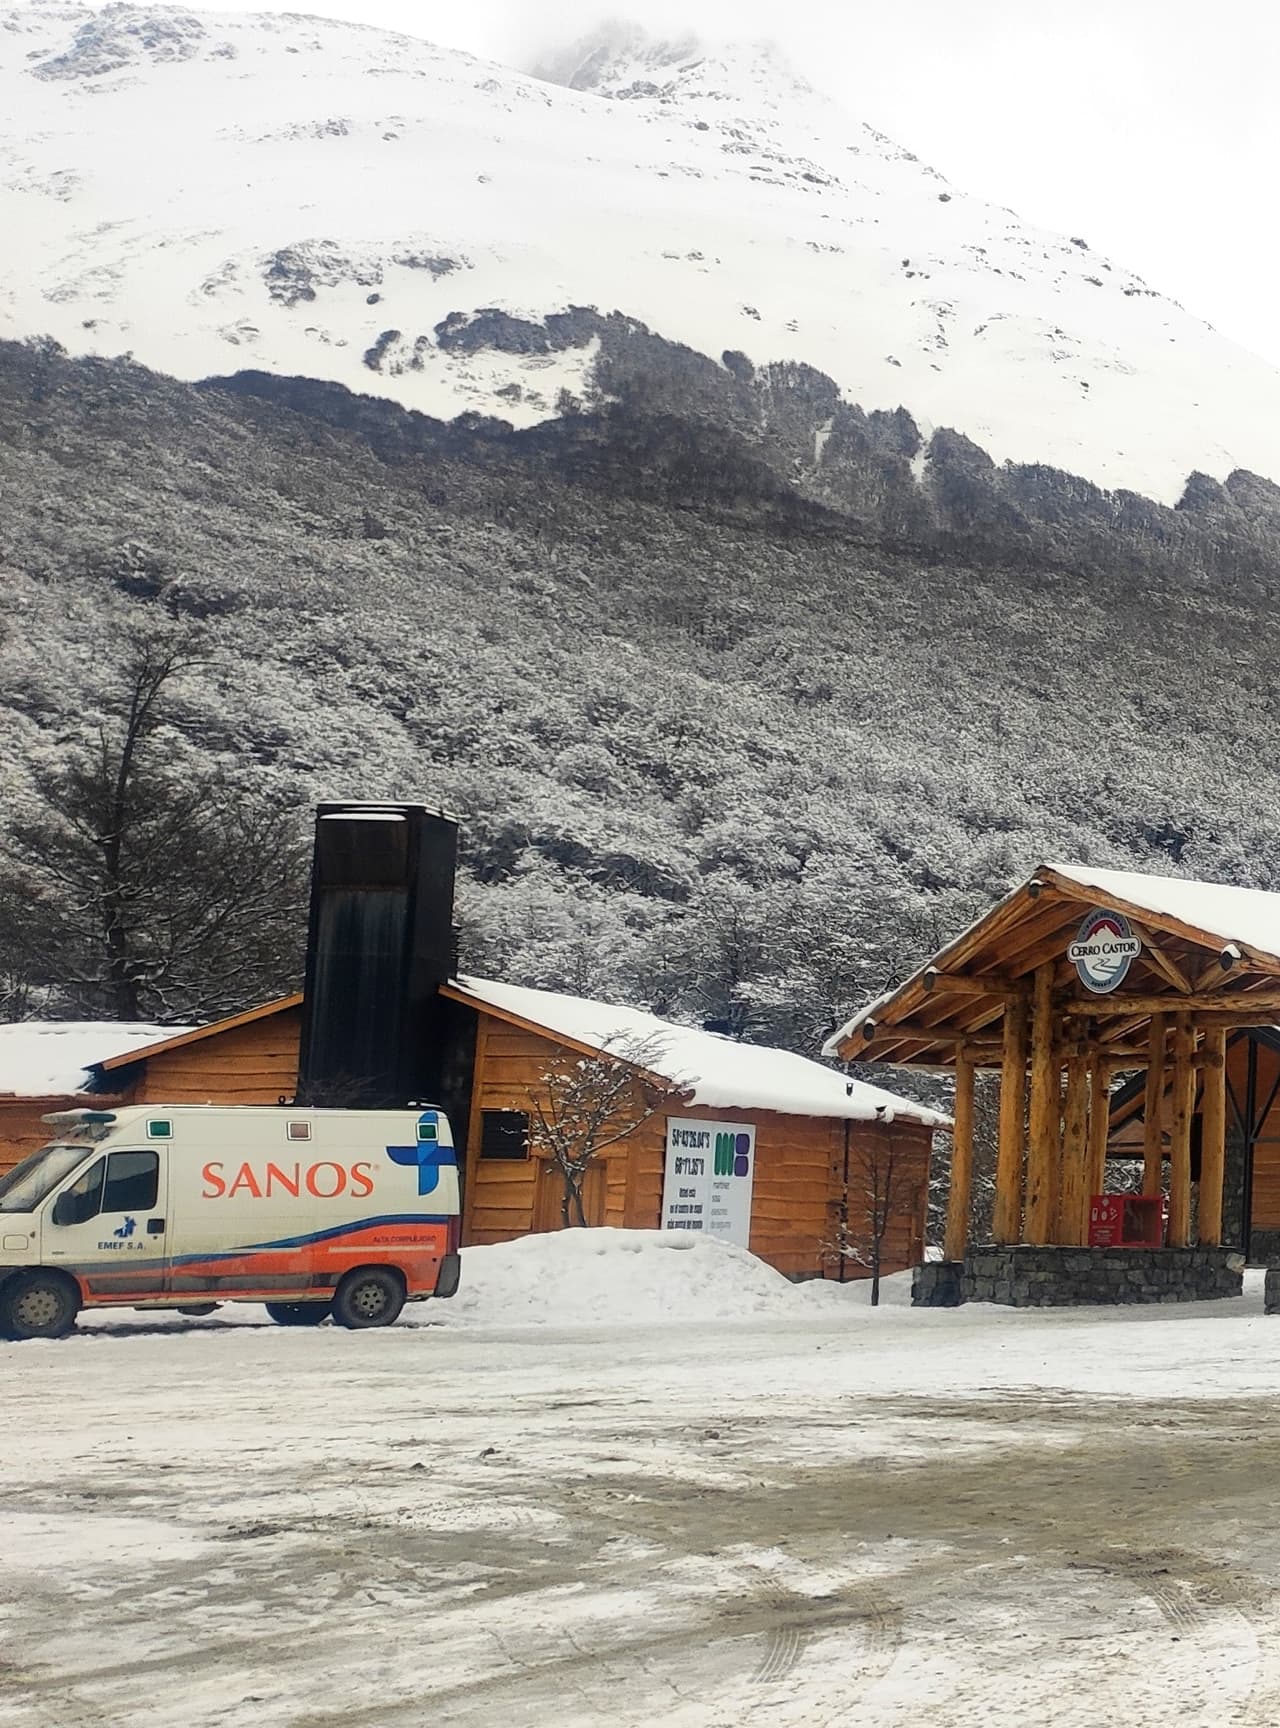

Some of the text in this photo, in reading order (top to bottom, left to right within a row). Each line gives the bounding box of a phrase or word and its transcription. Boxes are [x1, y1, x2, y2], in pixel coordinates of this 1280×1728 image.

[1071, 942, 1136, 957] CERRO CASTOR
[201, 1161, 375, 1199] SANOS
[97, 1241, 124, 1250] EMEF
